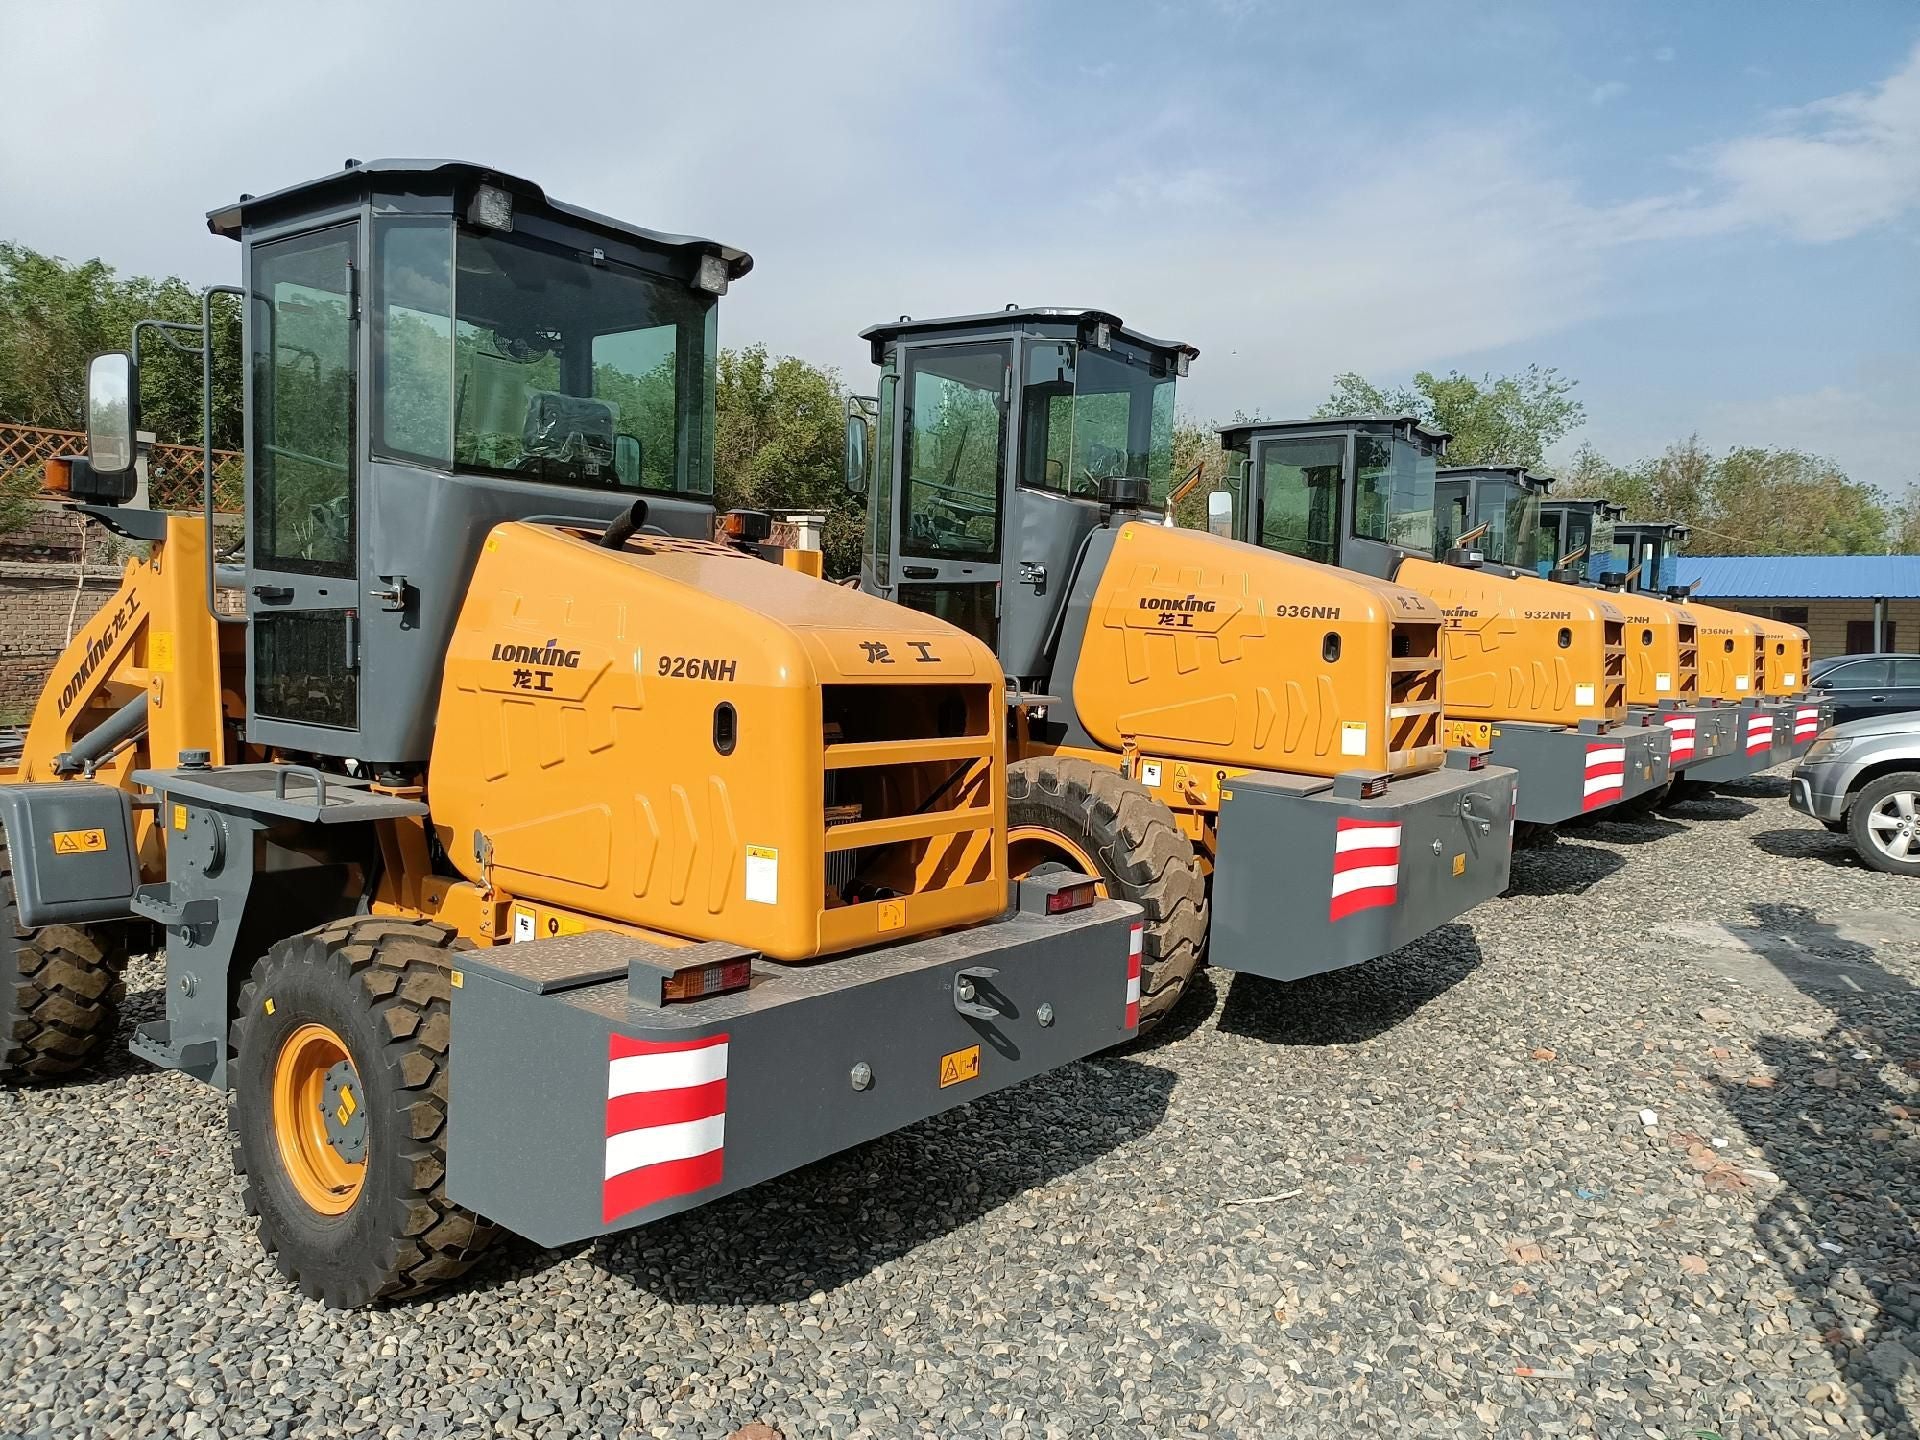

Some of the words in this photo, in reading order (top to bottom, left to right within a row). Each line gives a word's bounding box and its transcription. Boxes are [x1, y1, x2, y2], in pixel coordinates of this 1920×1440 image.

[1139, 594, 1216, 613] LONKING
[1276, 604, 1341, 620] 936NH
[1157, 612, 1194, 628] 龙工
[1523, 611, 1572, 620] 932NH
[1624, 616, 1650, 624] 2NH
[491, 638, 581, 669] LONKING
[859, 641, 942, 664] 龙工
[657, 655, 737, 682] 926NH
[512, 668, 554, 692] 龙工
